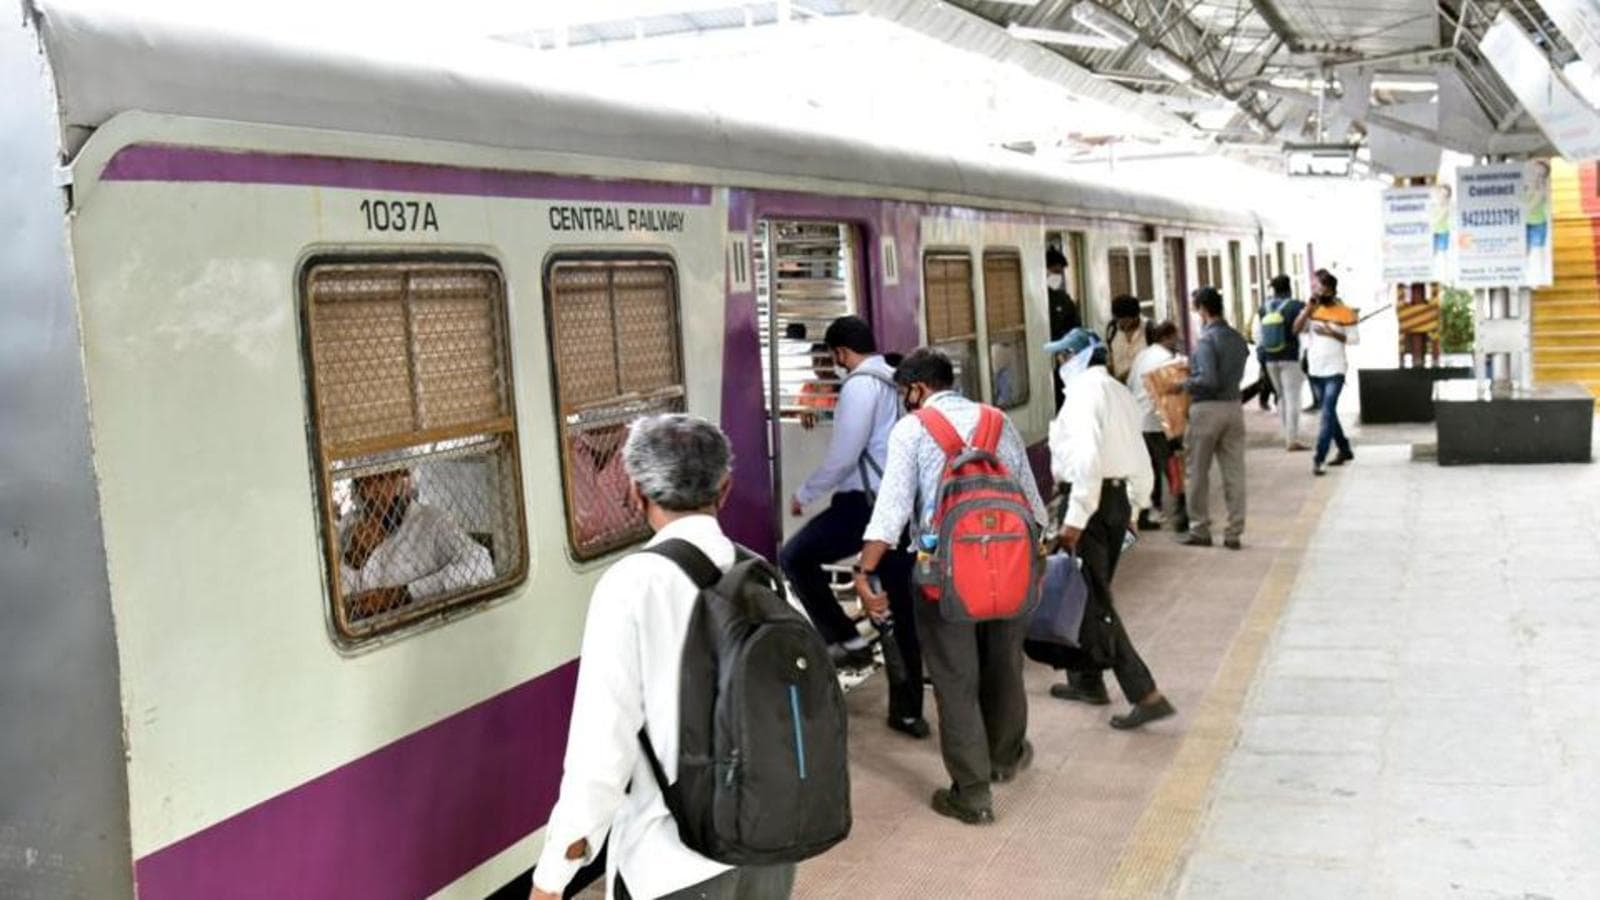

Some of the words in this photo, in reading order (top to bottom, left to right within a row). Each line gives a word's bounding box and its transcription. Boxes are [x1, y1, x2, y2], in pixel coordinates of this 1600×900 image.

[1468, 183, 1515, 197] Contact
[360, 199, 439, 232] 1037A
[549, 205, 624, 232] CENTRAL
[628, 208, 685, 233] RAILWAY
